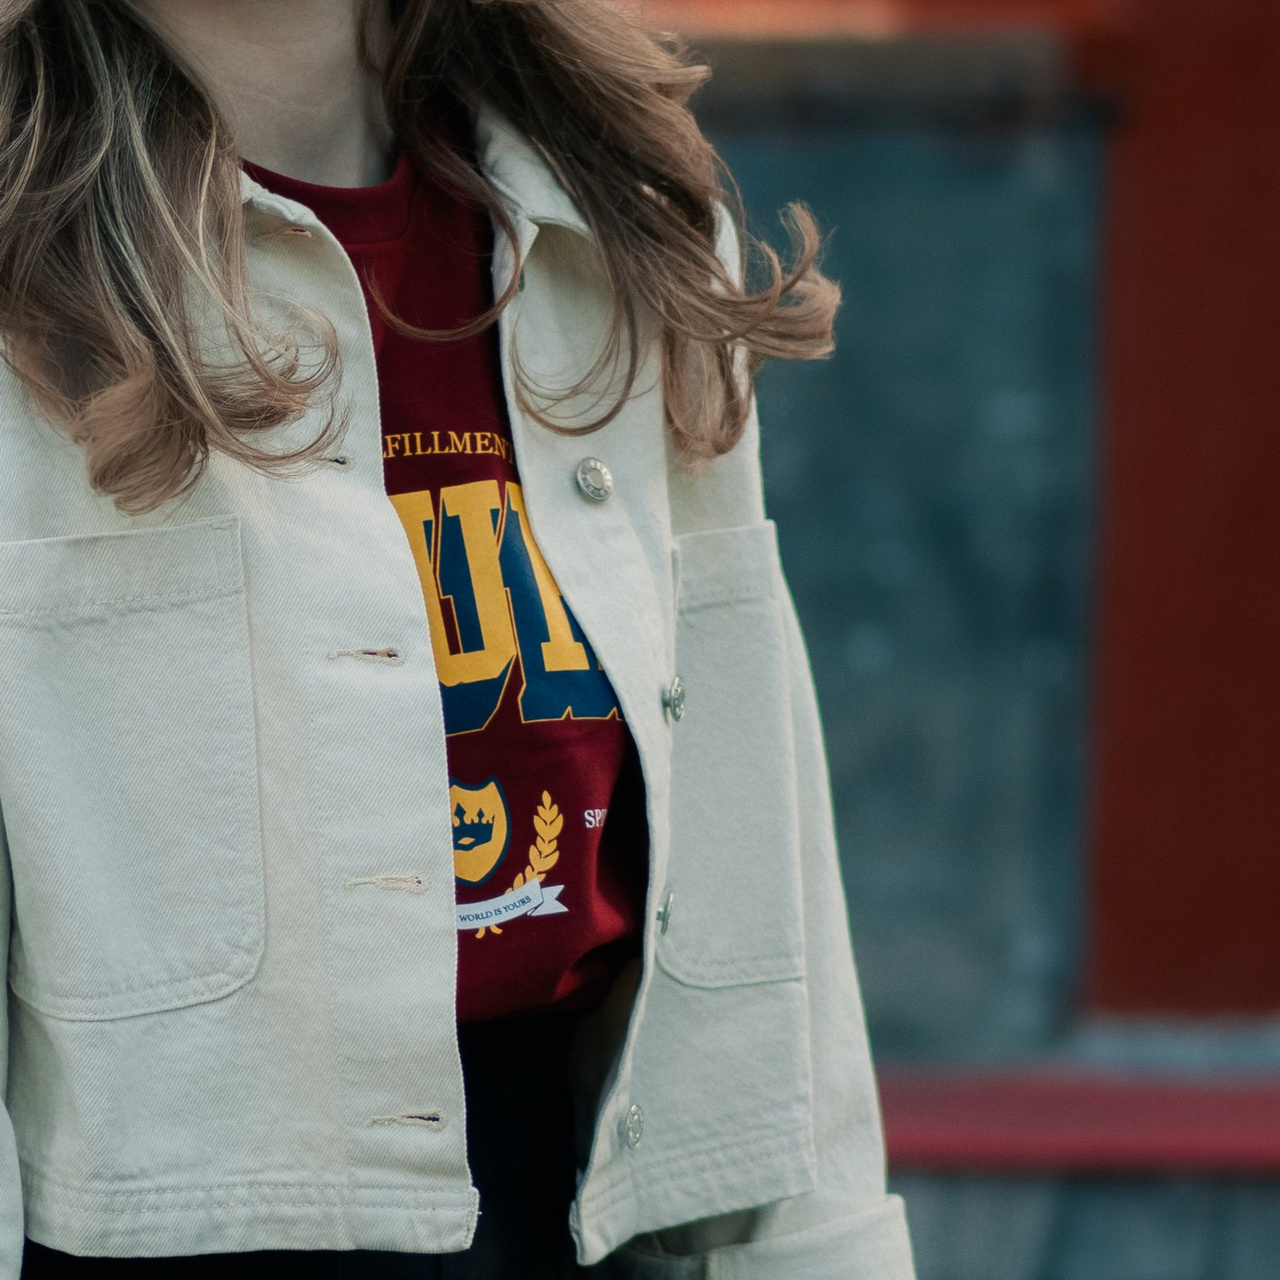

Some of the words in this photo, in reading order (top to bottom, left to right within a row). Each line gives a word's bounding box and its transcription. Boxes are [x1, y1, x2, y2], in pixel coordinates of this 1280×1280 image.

[459, 910, 493, 922] WORLD
[493, 907, 503, 916] IS
[503, 895, 532, 912] YOURS
